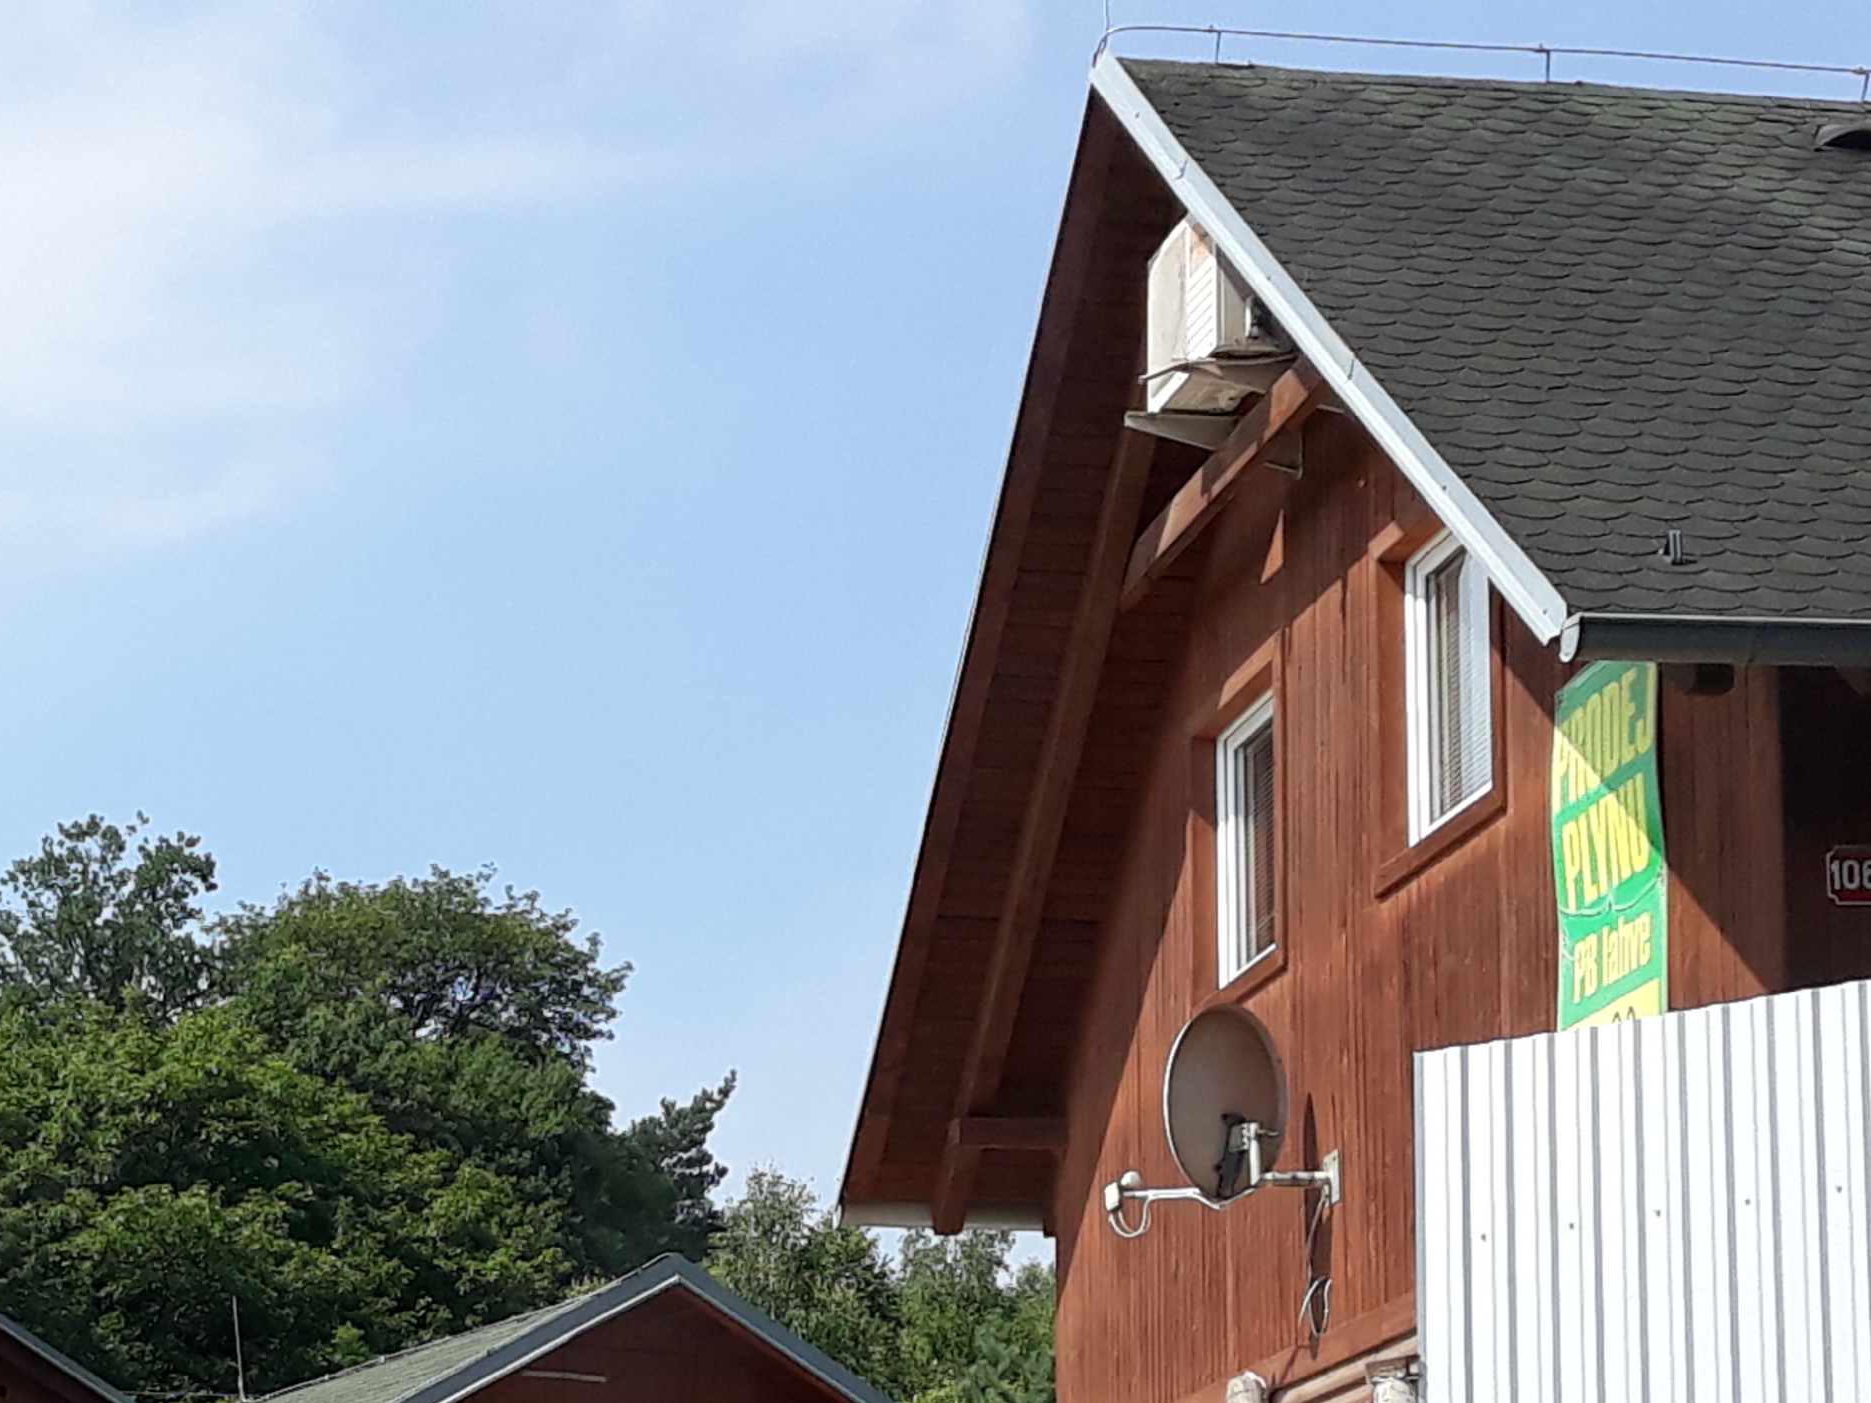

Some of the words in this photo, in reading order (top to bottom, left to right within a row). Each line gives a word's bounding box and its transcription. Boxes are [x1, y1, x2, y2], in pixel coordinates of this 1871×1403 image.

[1553, 661, 1657, 816] PRODEJ
[1562, 772, 1650, 912] PLYNU
[1573, 932, 1598, 1004] PB
[1602, 912, 1652, 987] lahve
